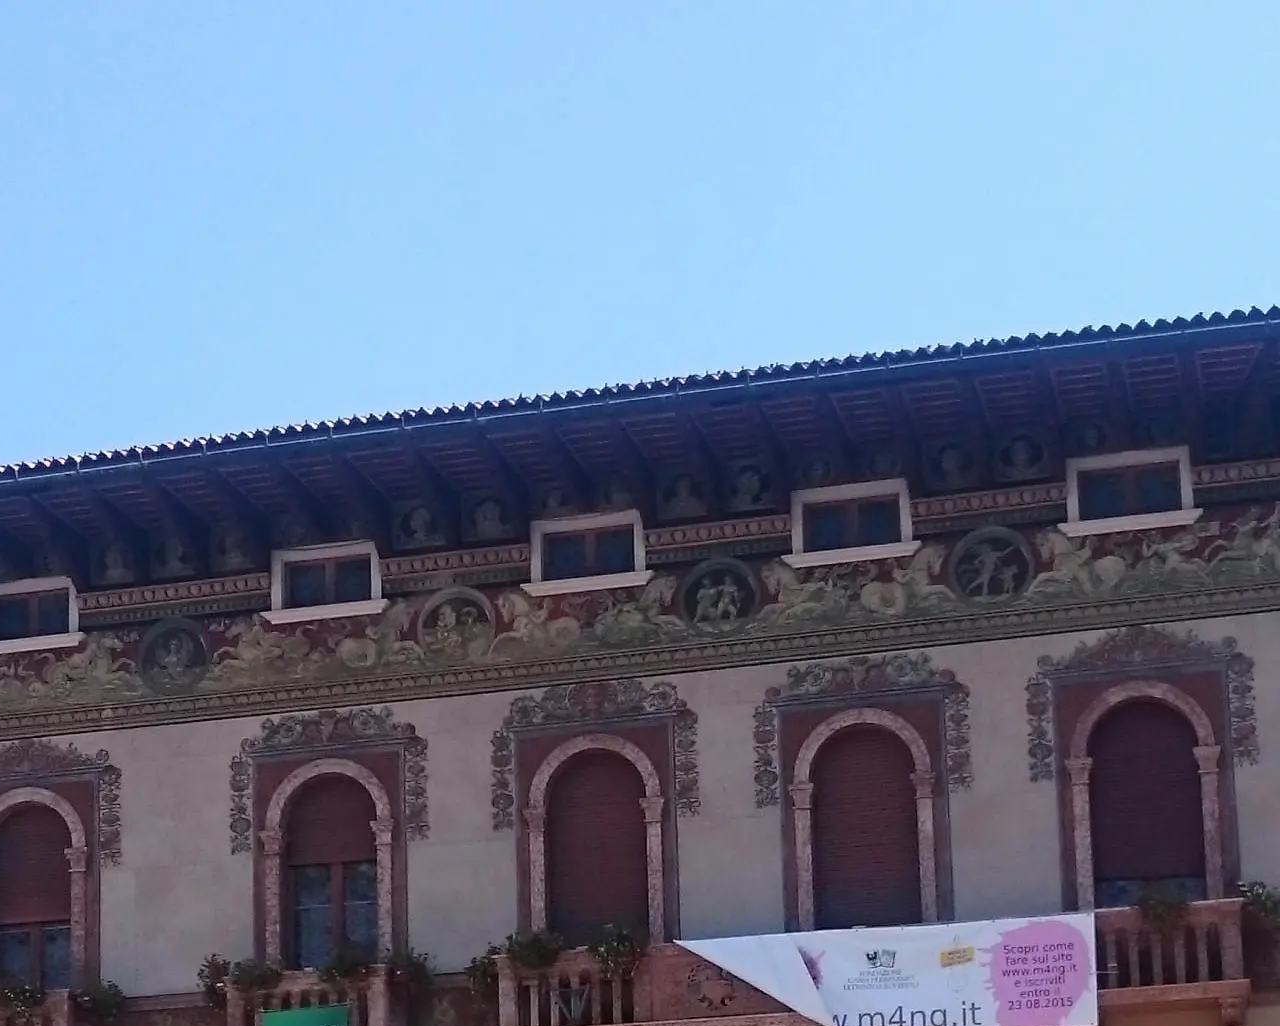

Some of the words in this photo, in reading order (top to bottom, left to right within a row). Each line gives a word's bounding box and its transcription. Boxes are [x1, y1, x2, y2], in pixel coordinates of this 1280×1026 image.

[1003, 944, 1039, 955] Scopri
[1043, 942, 1074, 952] come
[1006, 957, 1029, 966] fare
[1032, 955, 1049, 964] sul
[1052, 952, 1073, 962] sito
[1002, 963, 1078, 978] www.m4ng.it
[1014, 979, 1021, 988] e
[1025, 975, 1066, 987] iscriviti
[1020, 988, 1051, 999] entro
[1007, 996, 1074, 1011] 23.08.2015
